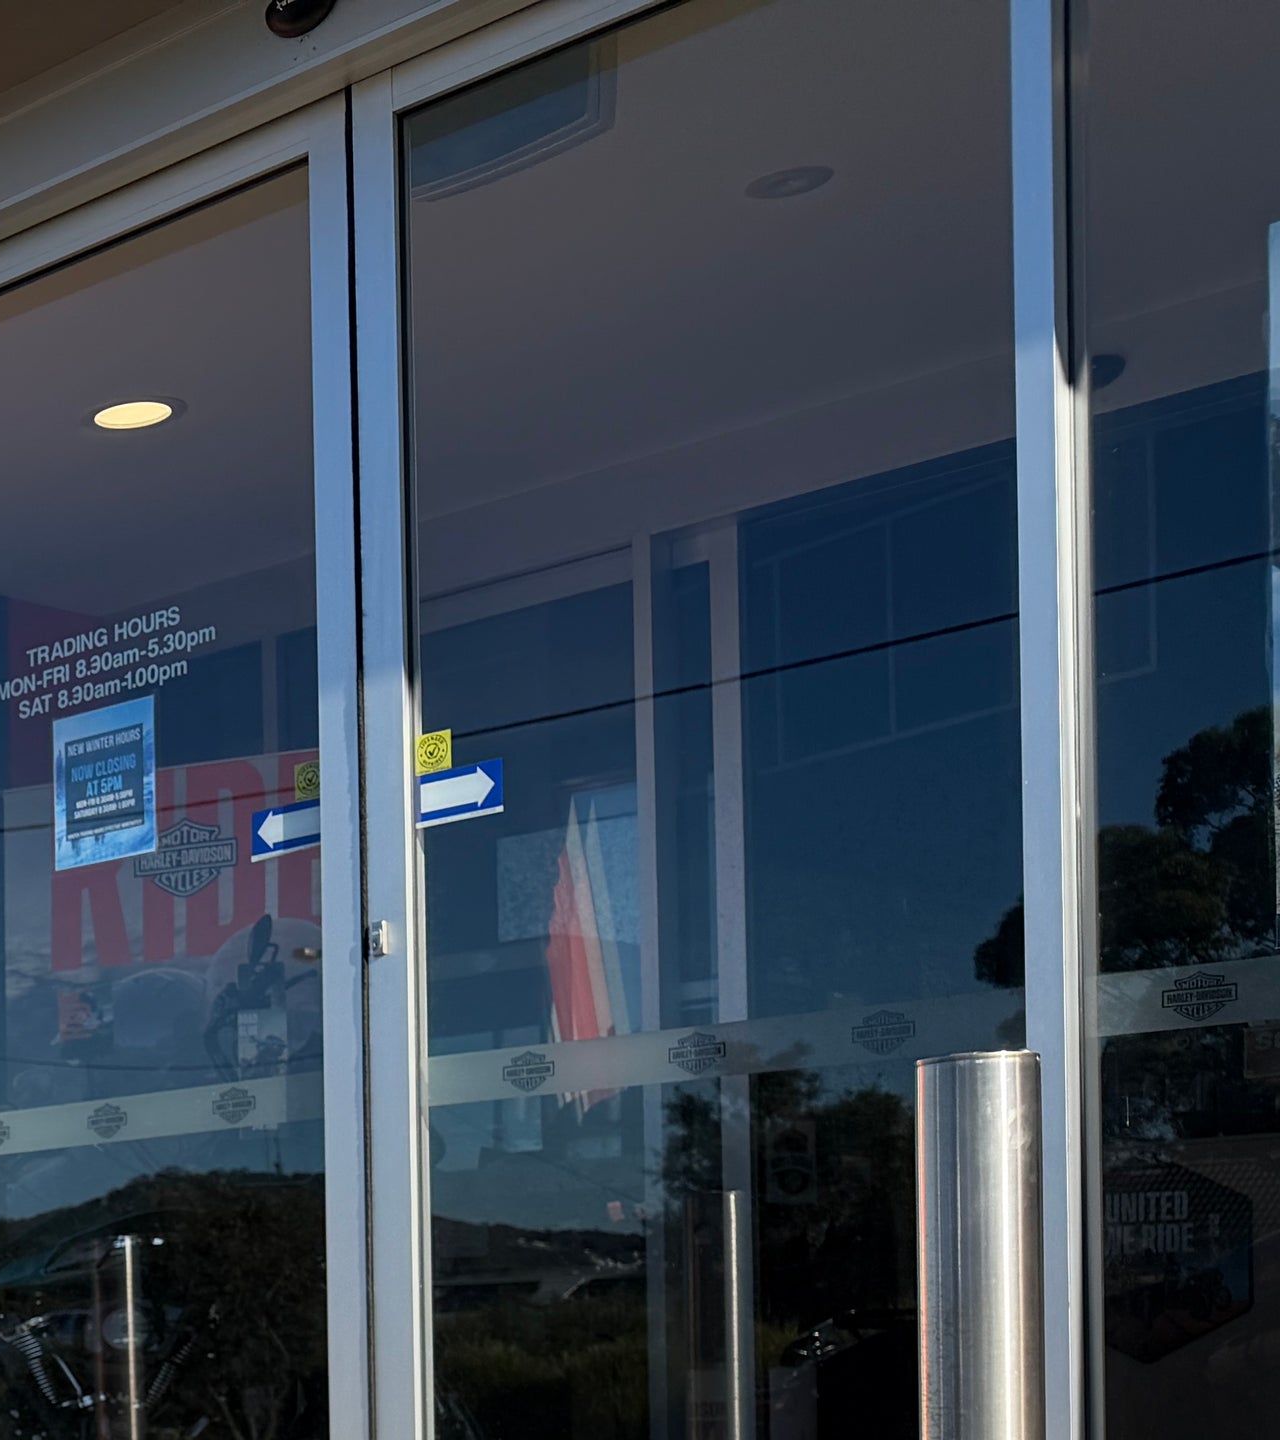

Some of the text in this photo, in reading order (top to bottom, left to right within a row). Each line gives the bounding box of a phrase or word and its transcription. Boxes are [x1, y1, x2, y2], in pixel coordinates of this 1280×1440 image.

[26, 606, 181, 668] TRADING HOURS
[18, 694, 53, 720] SAT
[67, 727, 141, 757] NEW WINTER HOURS
[71, 753, 137, 783] NOW CLOSING
[86, 774, 123, 798] AT 5PM
[160, 826, 210, 847] MOTOR
[140, 844, 232, 871] HARLEY-DAVIDSON
[161, 868, 210, 891] CYCLES
[1105, 1191, 1189, 1223] UNITED
